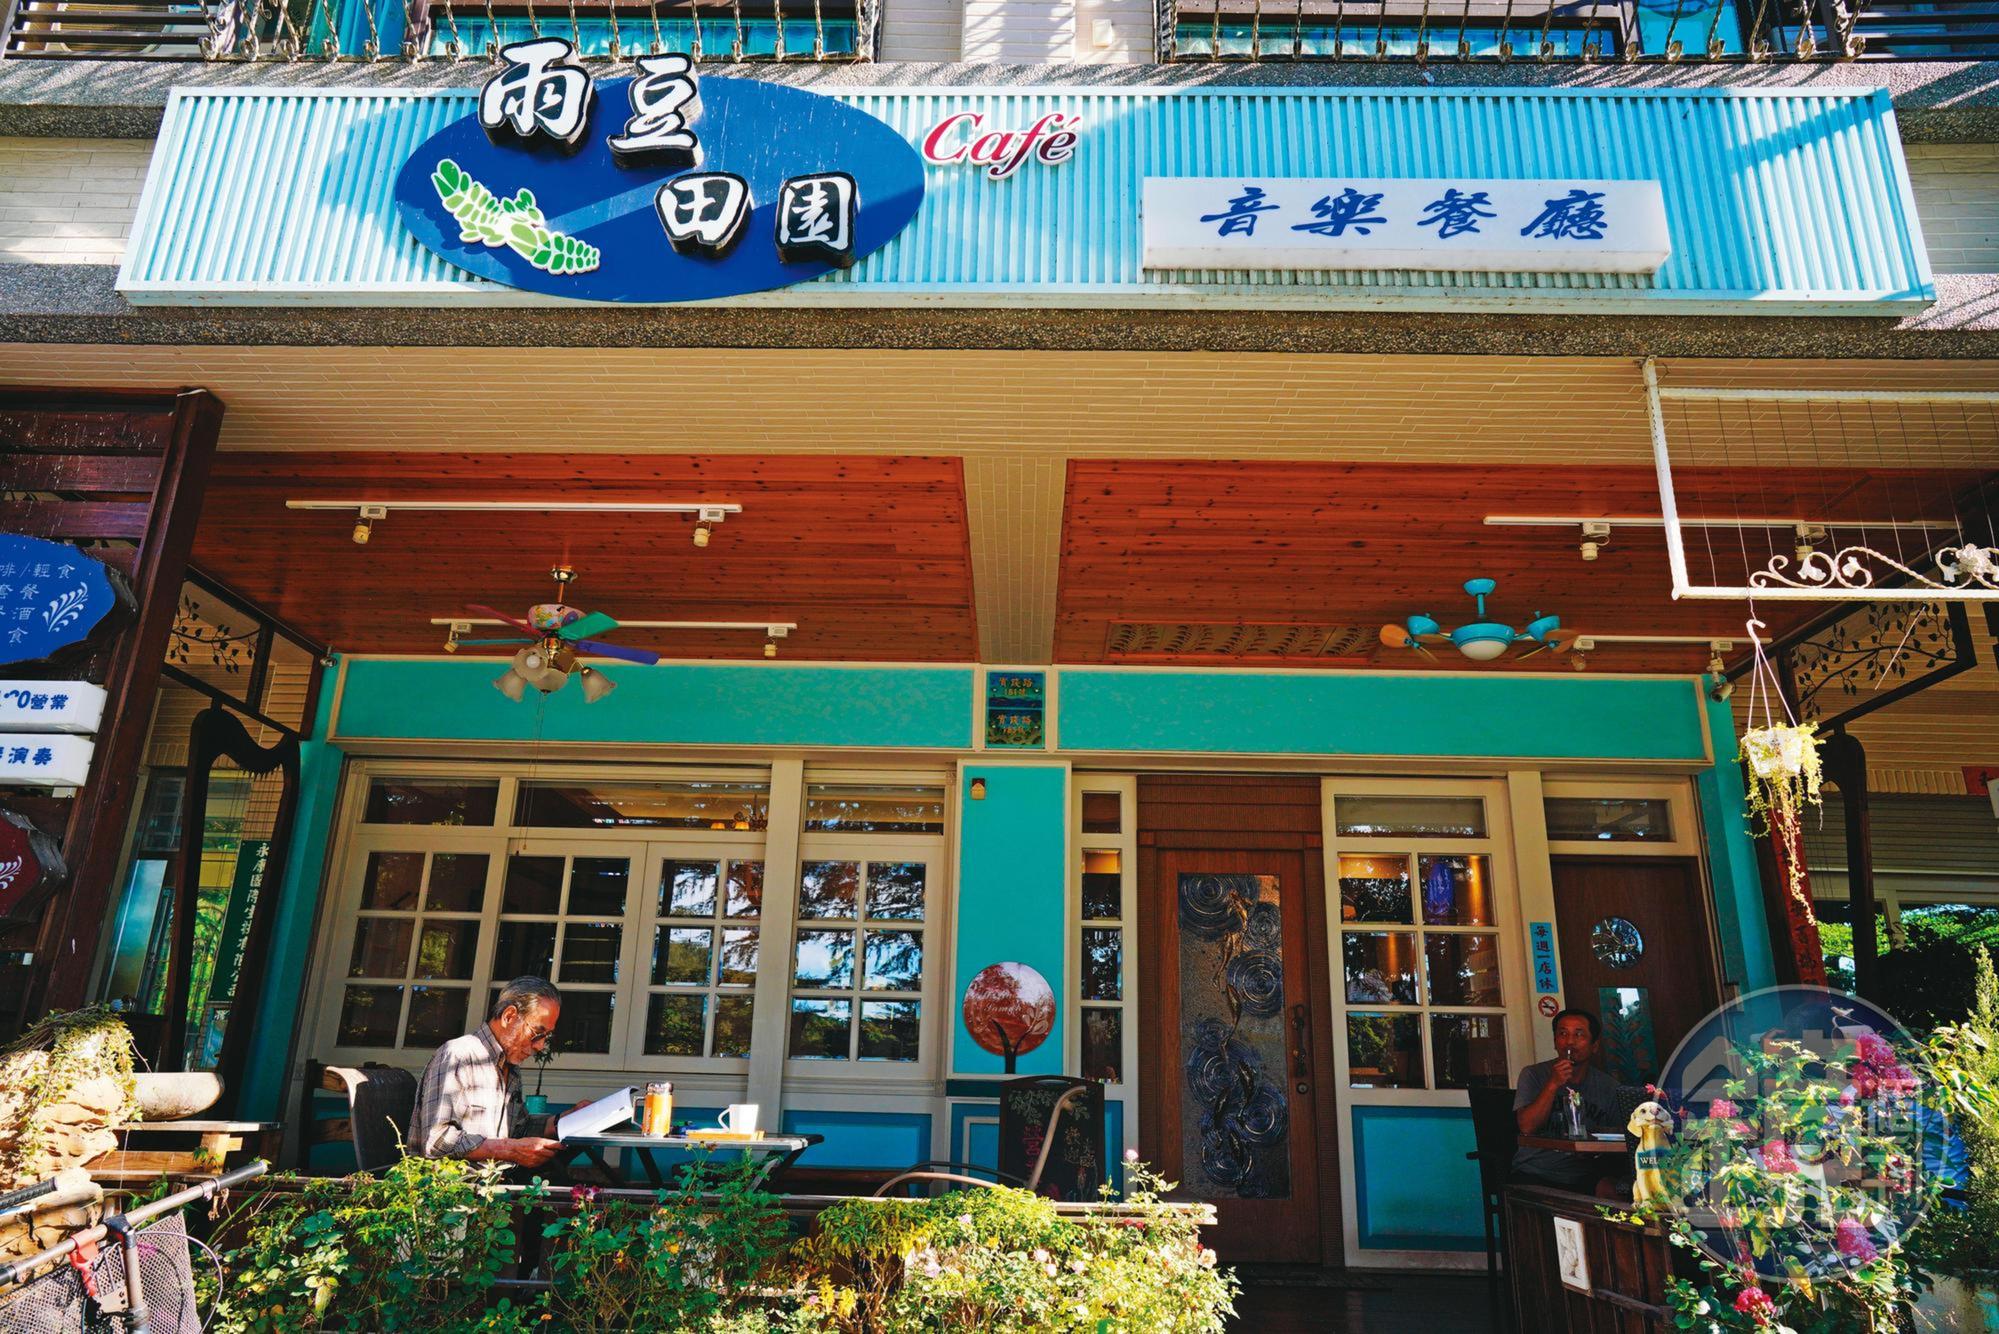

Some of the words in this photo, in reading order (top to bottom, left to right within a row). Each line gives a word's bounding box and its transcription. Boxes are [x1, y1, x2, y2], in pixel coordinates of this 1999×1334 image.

[478, 37, 699, 151] 雨豆
[923, 111, 1082, 180] Café
[654, 171, 857, 252] 田園
[1199, 186, 1609, 241] 音樂餐廳
[0, 605, 36, 620] 酒
[0, 746, 52, 765] 演奏
[1534, 925, 1554, 990] 每週一店休
